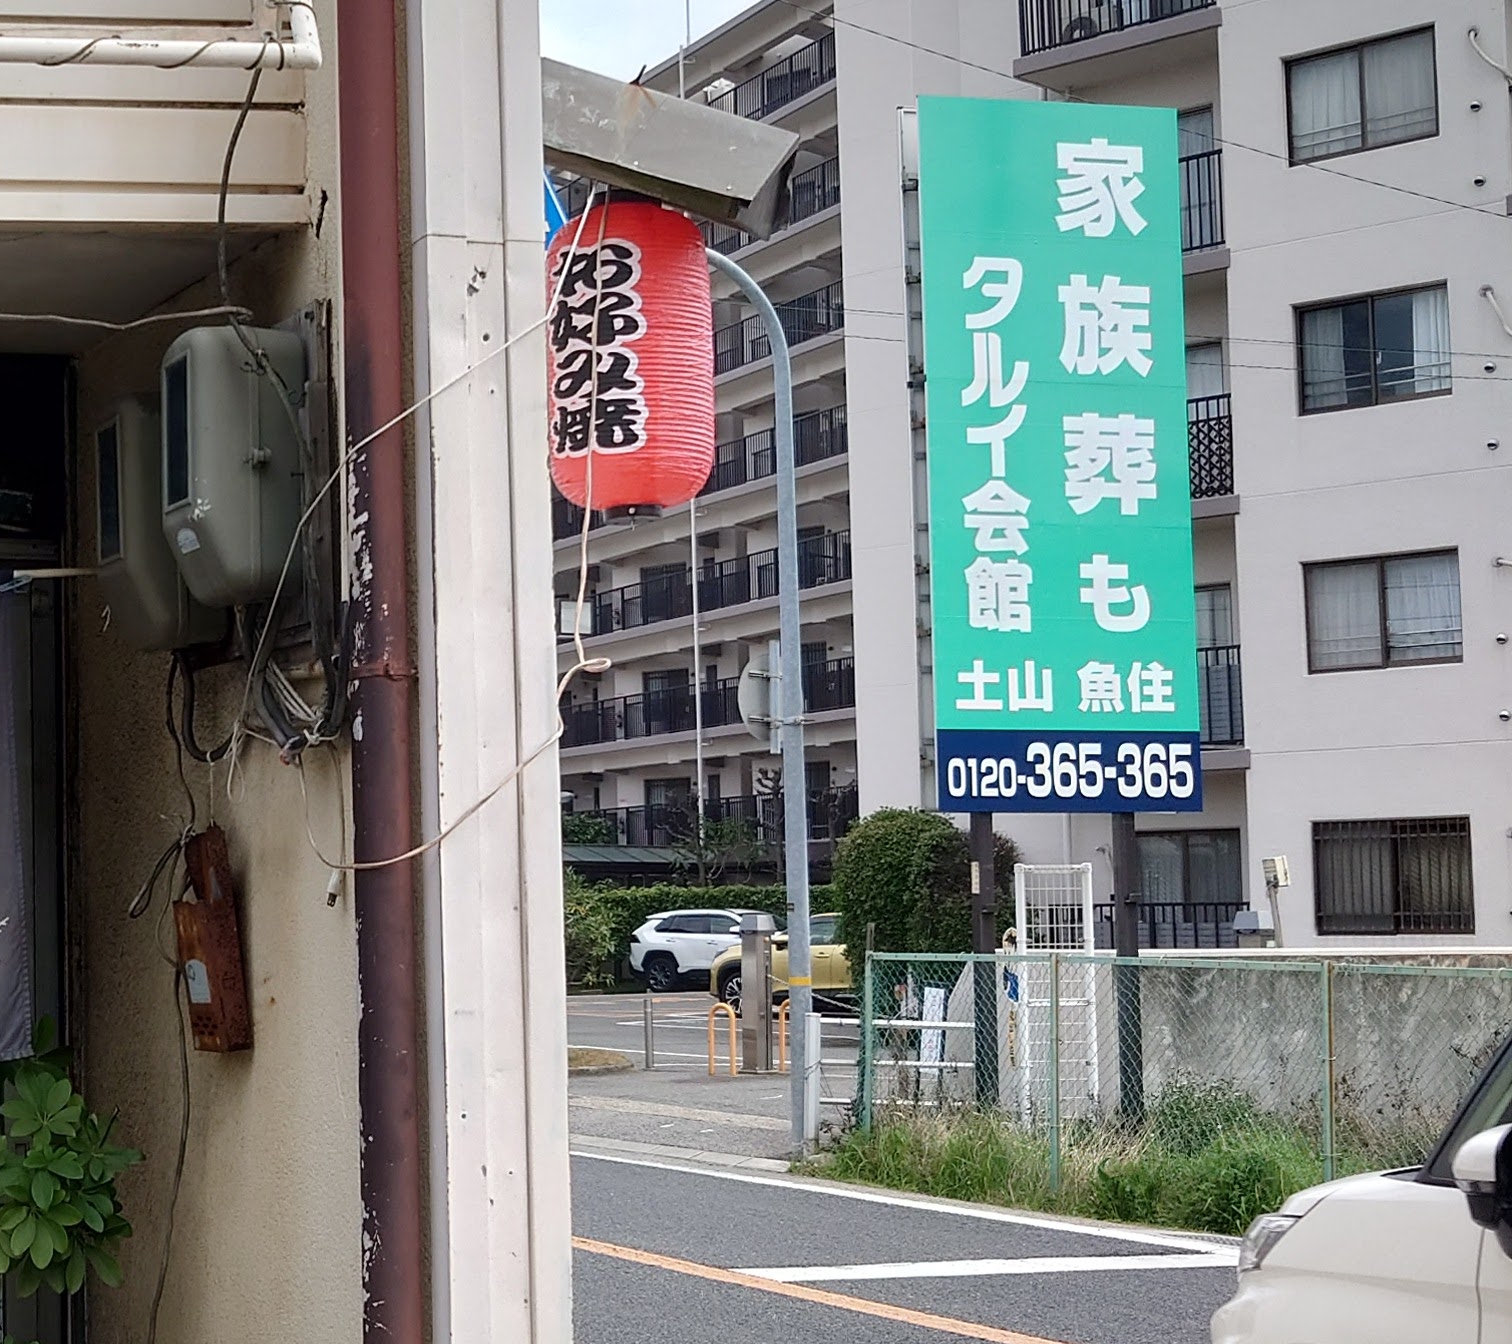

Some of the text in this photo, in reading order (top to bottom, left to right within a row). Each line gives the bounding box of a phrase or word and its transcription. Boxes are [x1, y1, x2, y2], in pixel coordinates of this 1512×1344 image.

[962, 256, 1031, 634] タルイ会館
[1055, 137, 1157, 633] 家族葬も
[948, 742, 1194, 799] 0120-365-365
[956, 661, 1175, 713] 土山 魚住
